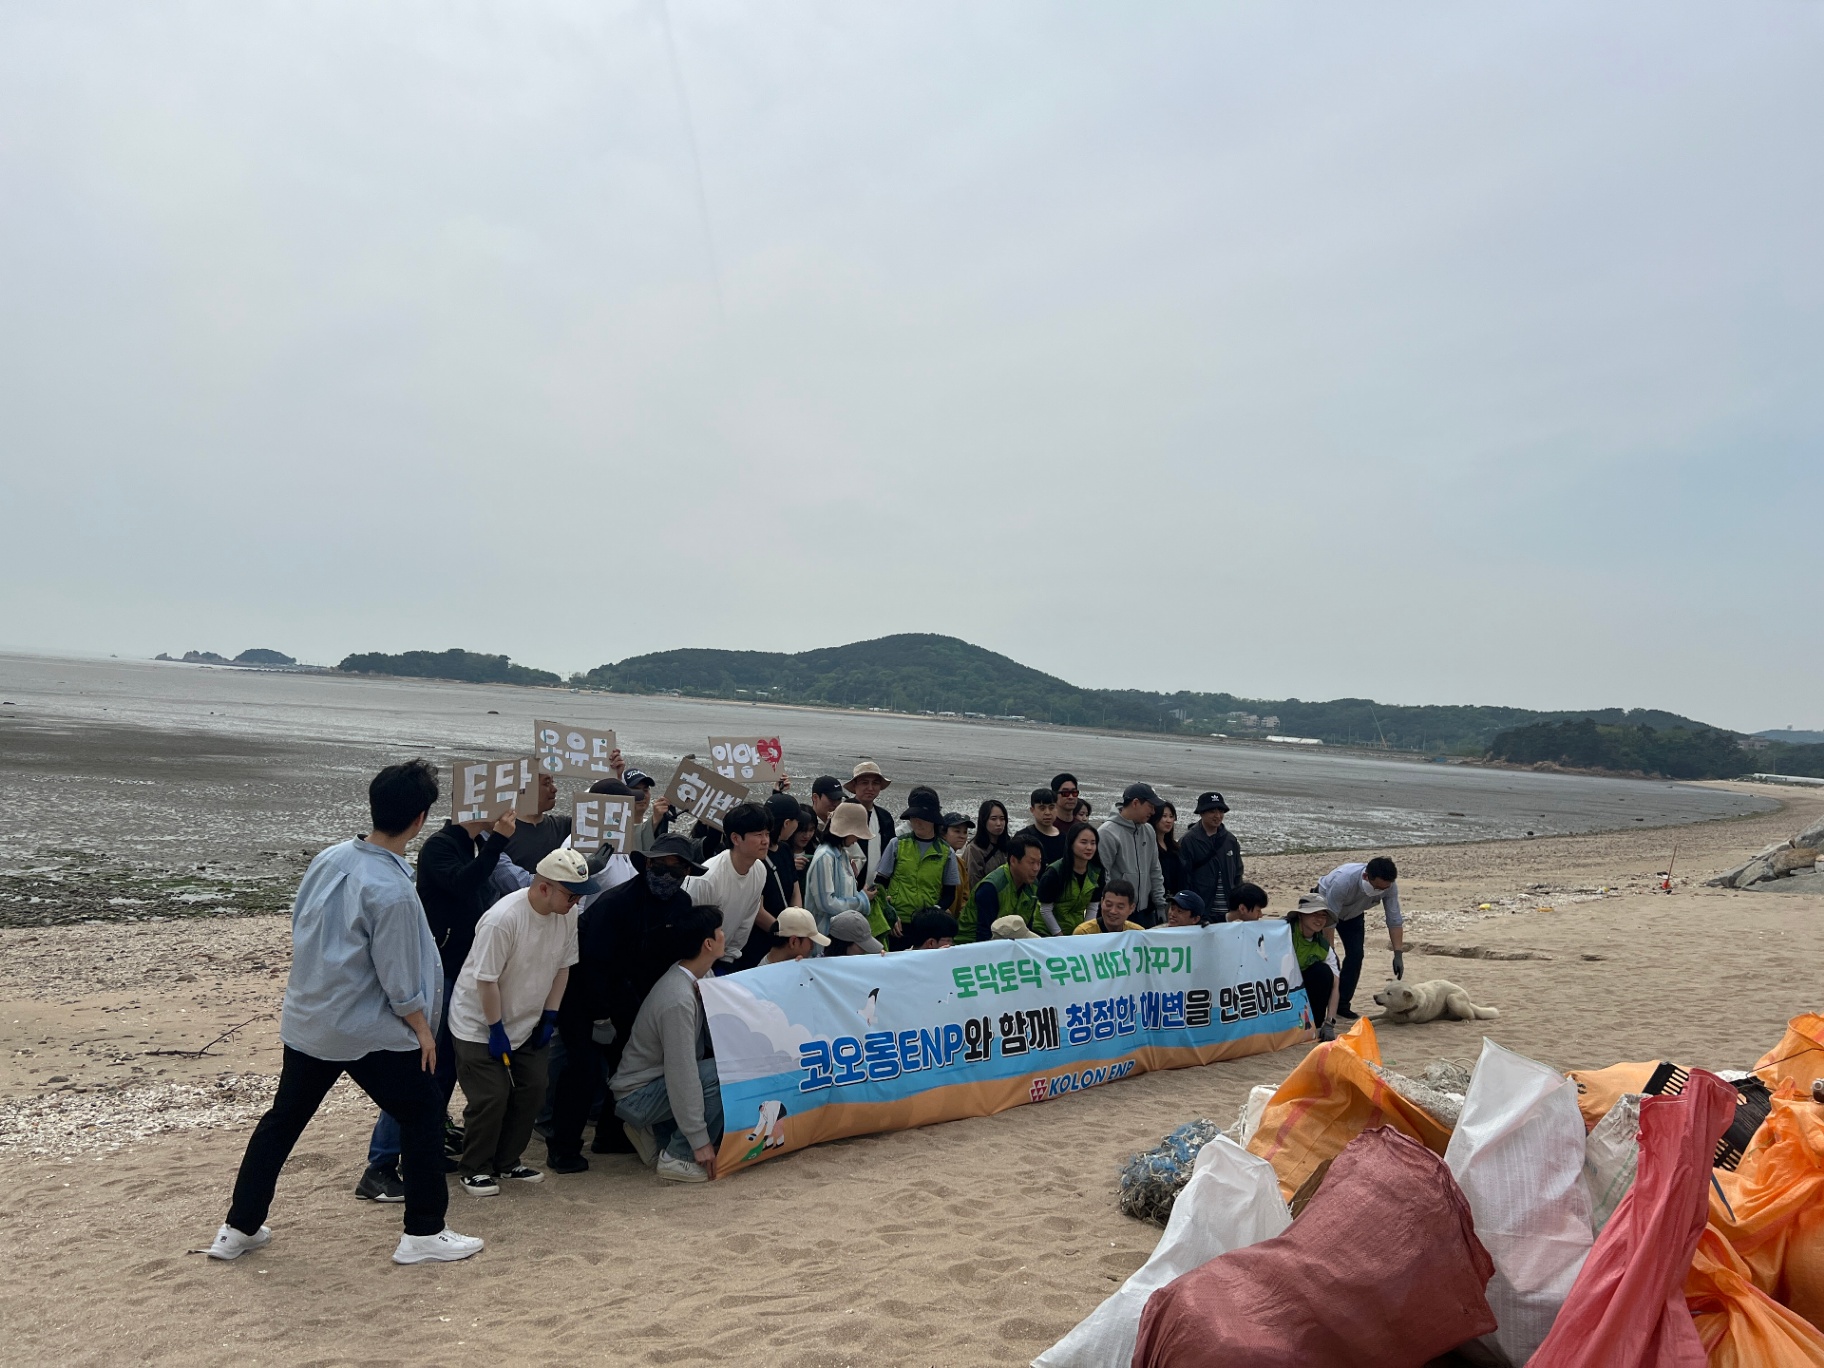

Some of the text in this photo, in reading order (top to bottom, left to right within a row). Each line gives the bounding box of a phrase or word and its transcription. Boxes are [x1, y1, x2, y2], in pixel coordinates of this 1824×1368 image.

[539, 729, 610, 772] 용유도
[711, 742, 761, 779] 입양
[457, 759, 533, 823] 토닥
[573, 800, 632, 853] 토닥
[952, 946, 1192, 999] 토닥토닥 우리 바다 가꾸기
[798, 976, 1293, 1093] 코오롱ENP와 함께 청정한 해변을 만들어요
[1048, 1059, 1136, 1097] KOLON ENP
